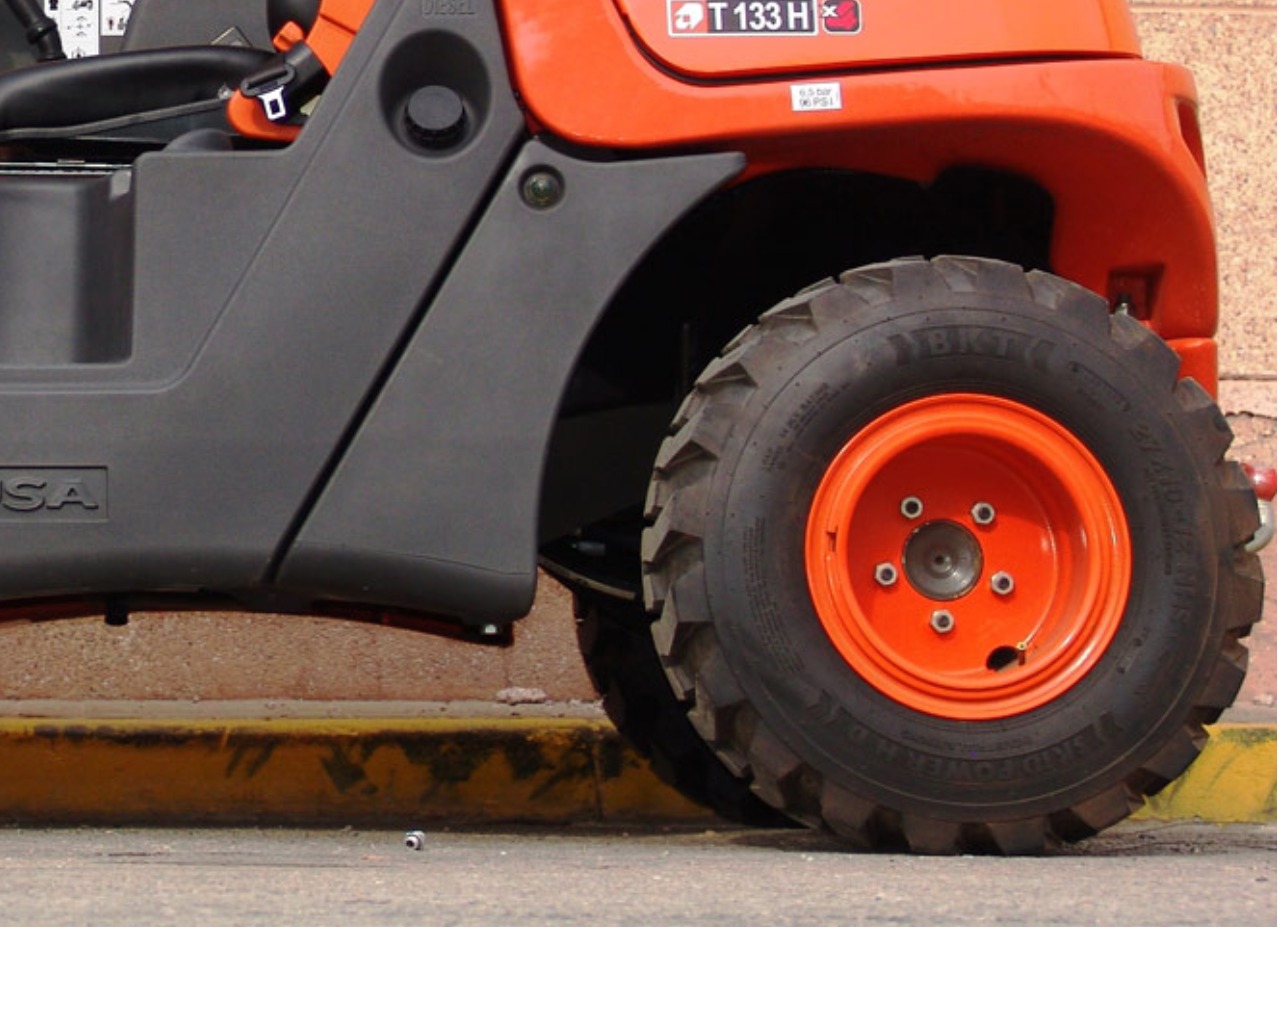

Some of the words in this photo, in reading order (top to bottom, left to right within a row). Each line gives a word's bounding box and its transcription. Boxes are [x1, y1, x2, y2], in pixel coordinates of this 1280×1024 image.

[708, 2, 728, 30] T
[734, 1, 782, 30] 133
[788, 1, 808, 30] H
[927, 328, 1016, 357] BKT
